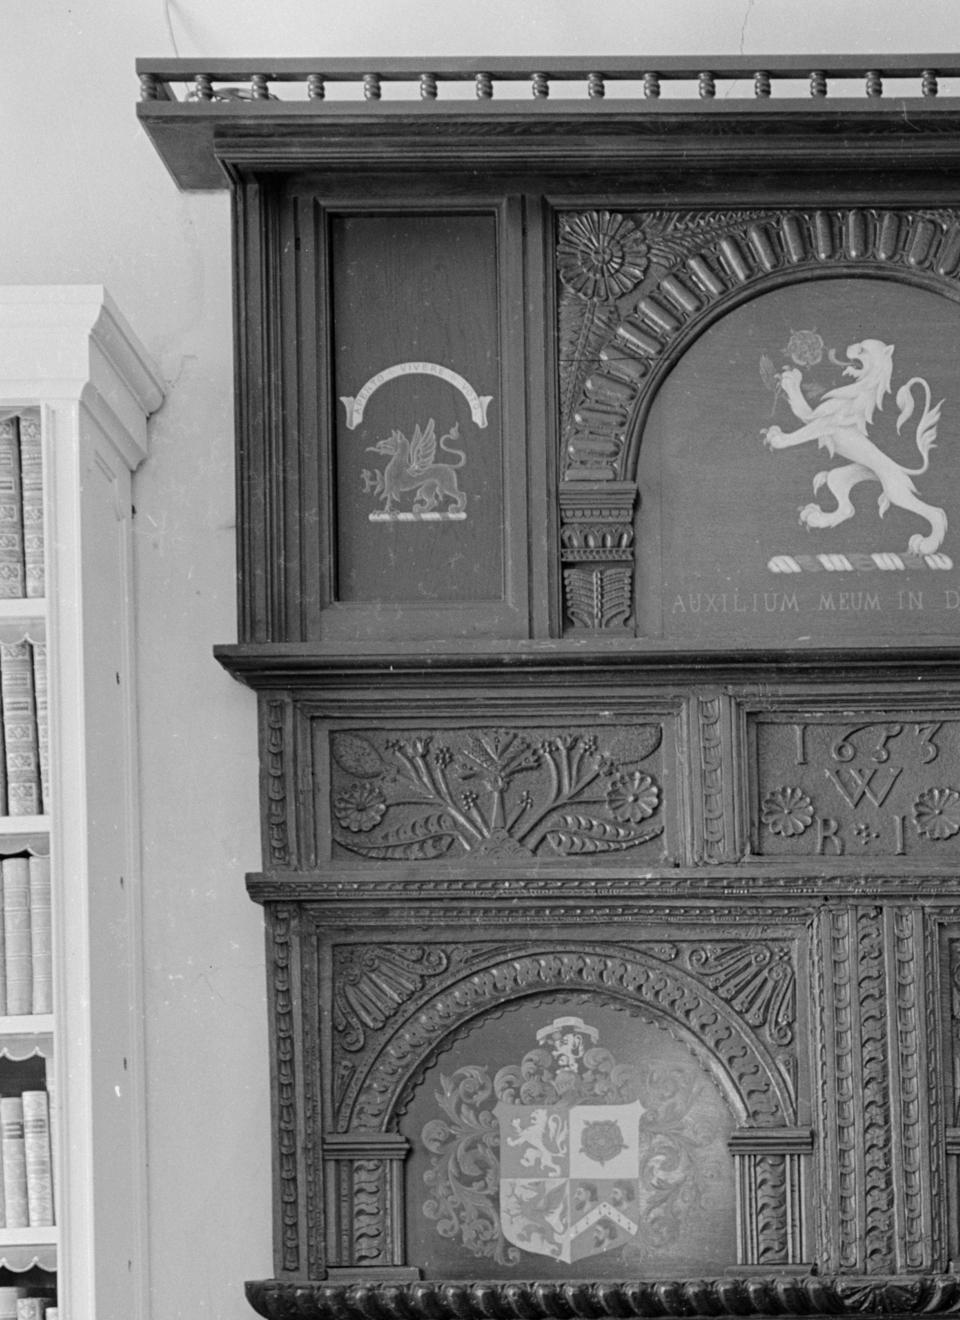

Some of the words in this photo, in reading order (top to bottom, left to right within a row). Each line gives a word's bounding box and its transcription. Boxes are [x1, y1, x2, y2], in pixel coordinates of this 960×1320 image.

[672, 592, 800, 613] AUXILIUM
[819, 591, 880, 611] MEUM
[899, 590, 924, 610] IN
[825, 767, 904, 809] W
